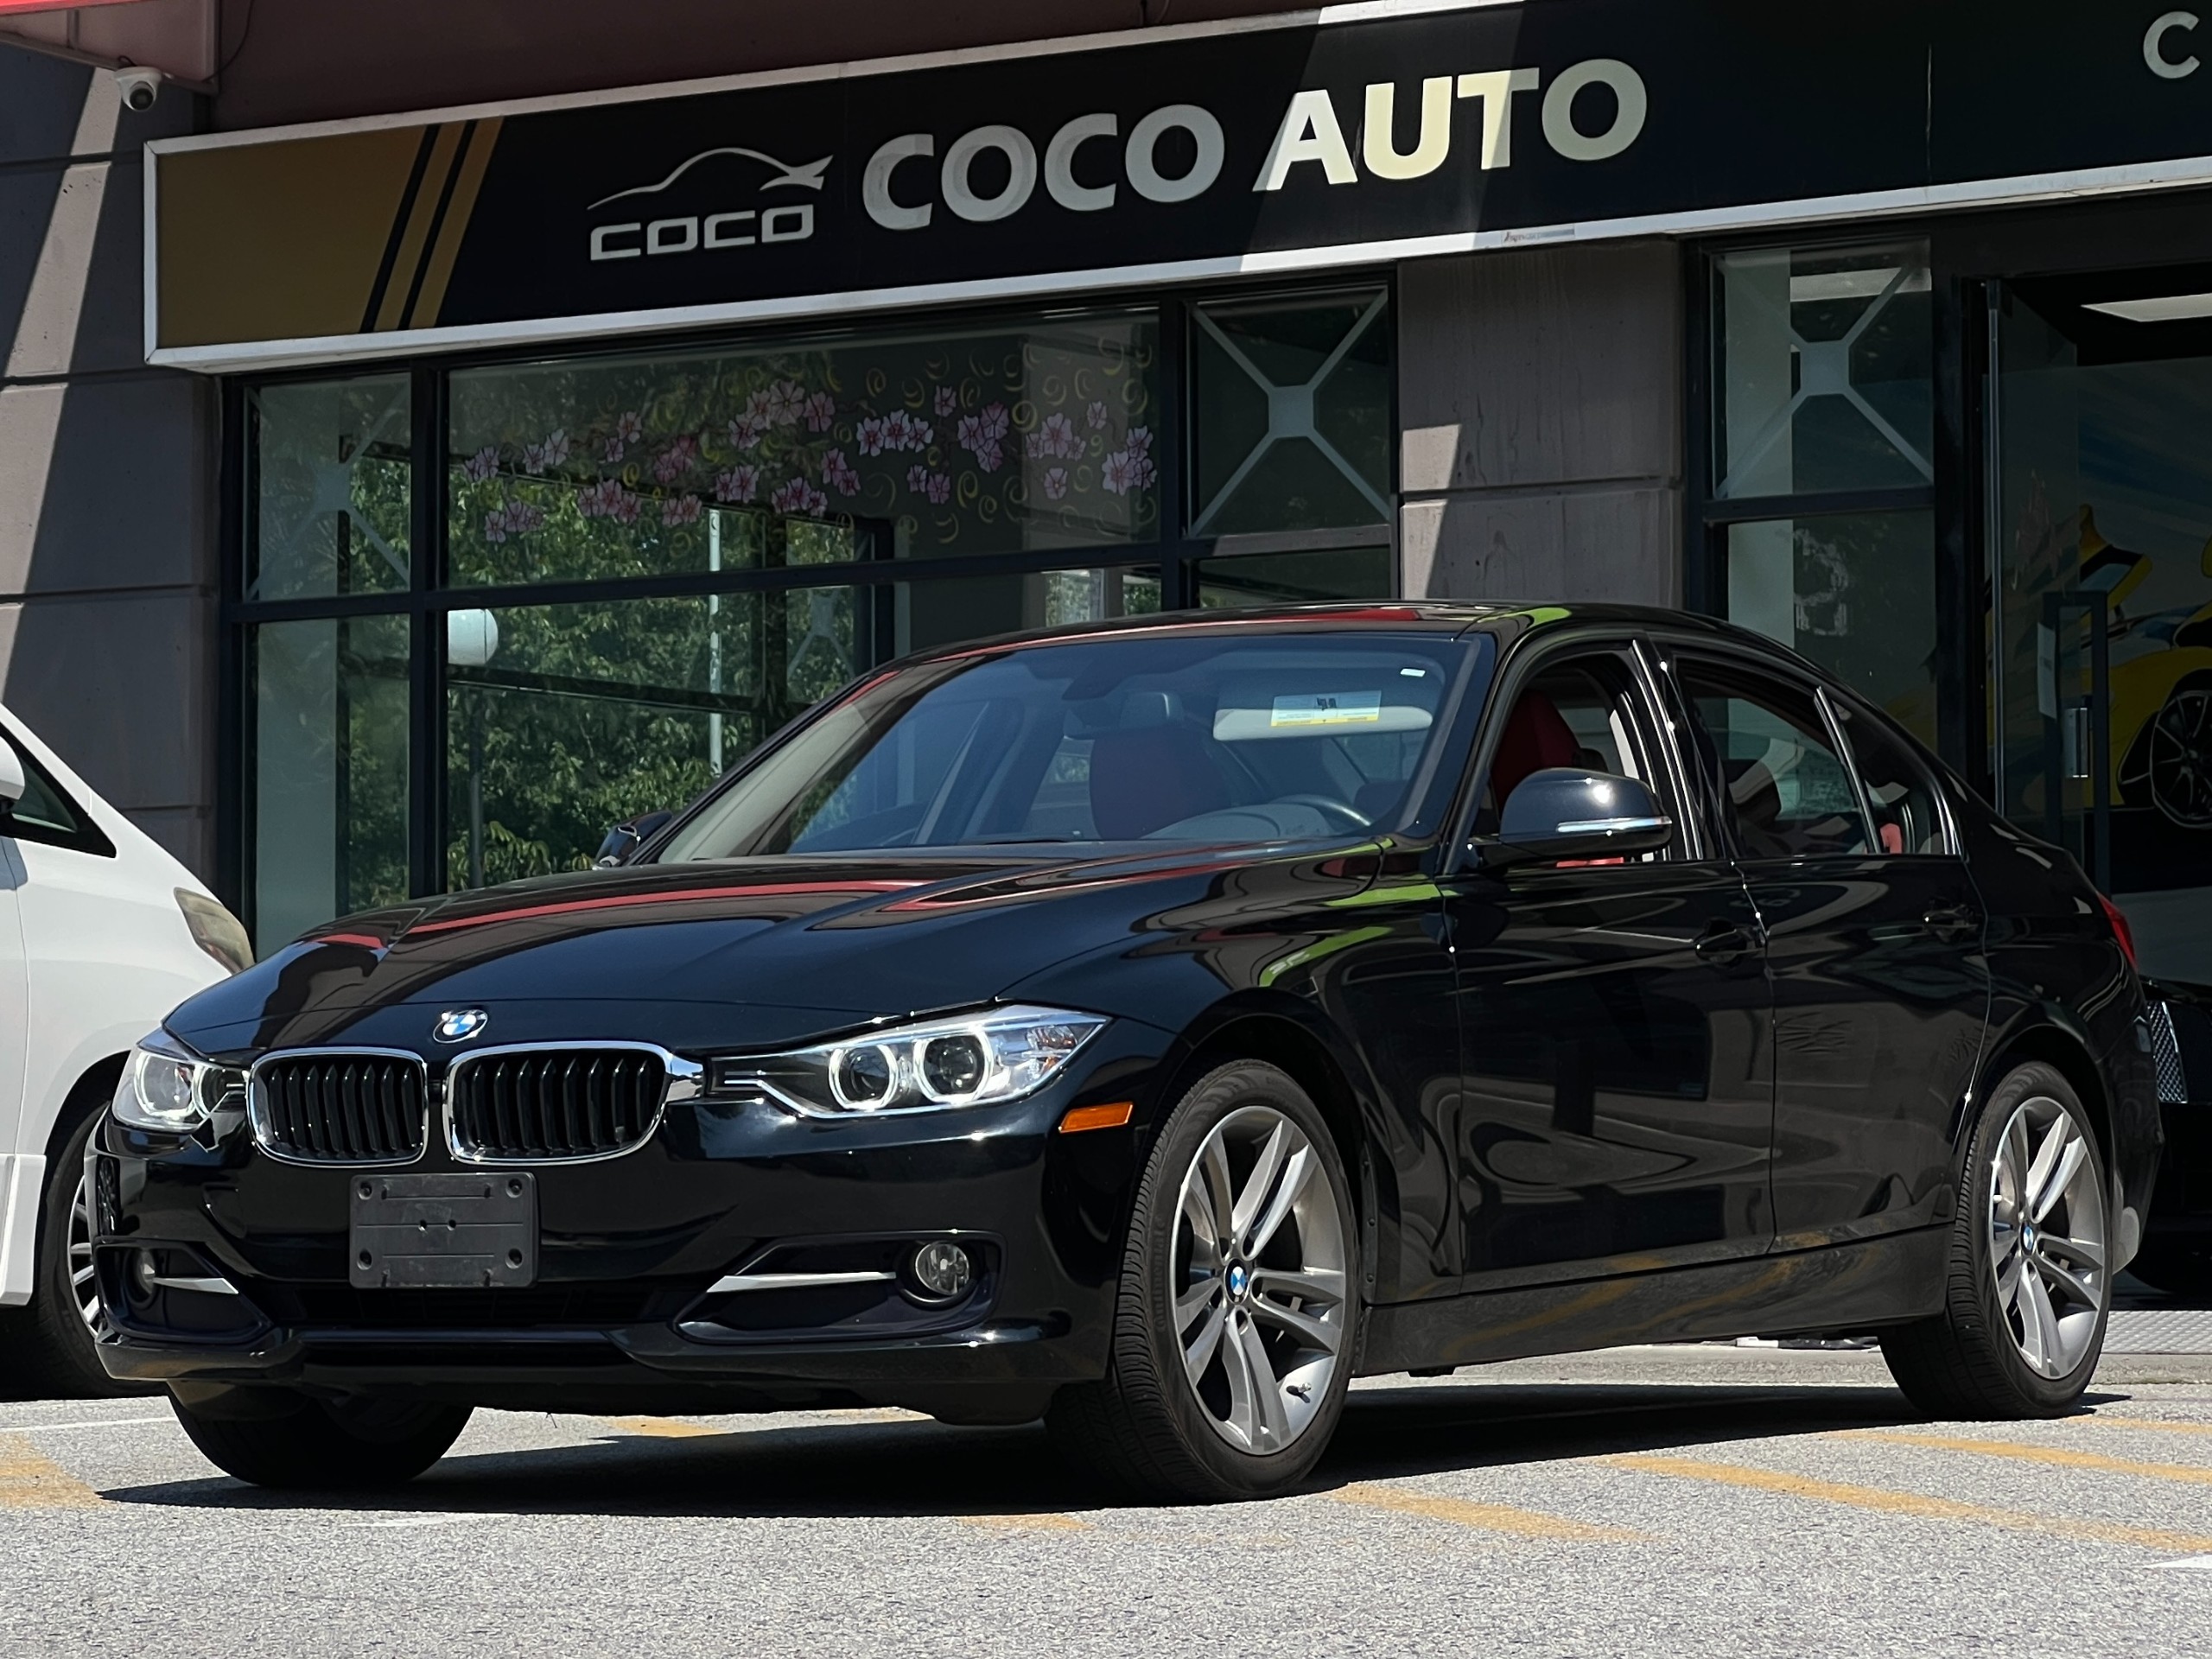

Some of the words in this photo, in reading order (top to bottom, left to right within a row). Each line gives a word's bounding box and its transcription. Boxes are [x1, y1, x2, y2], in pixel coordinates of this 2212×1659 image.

[862, 104, 1225, 231] COCO
[1252, 59, 1648, 192] AUTO
[590, 205, 814, 261] COCO
